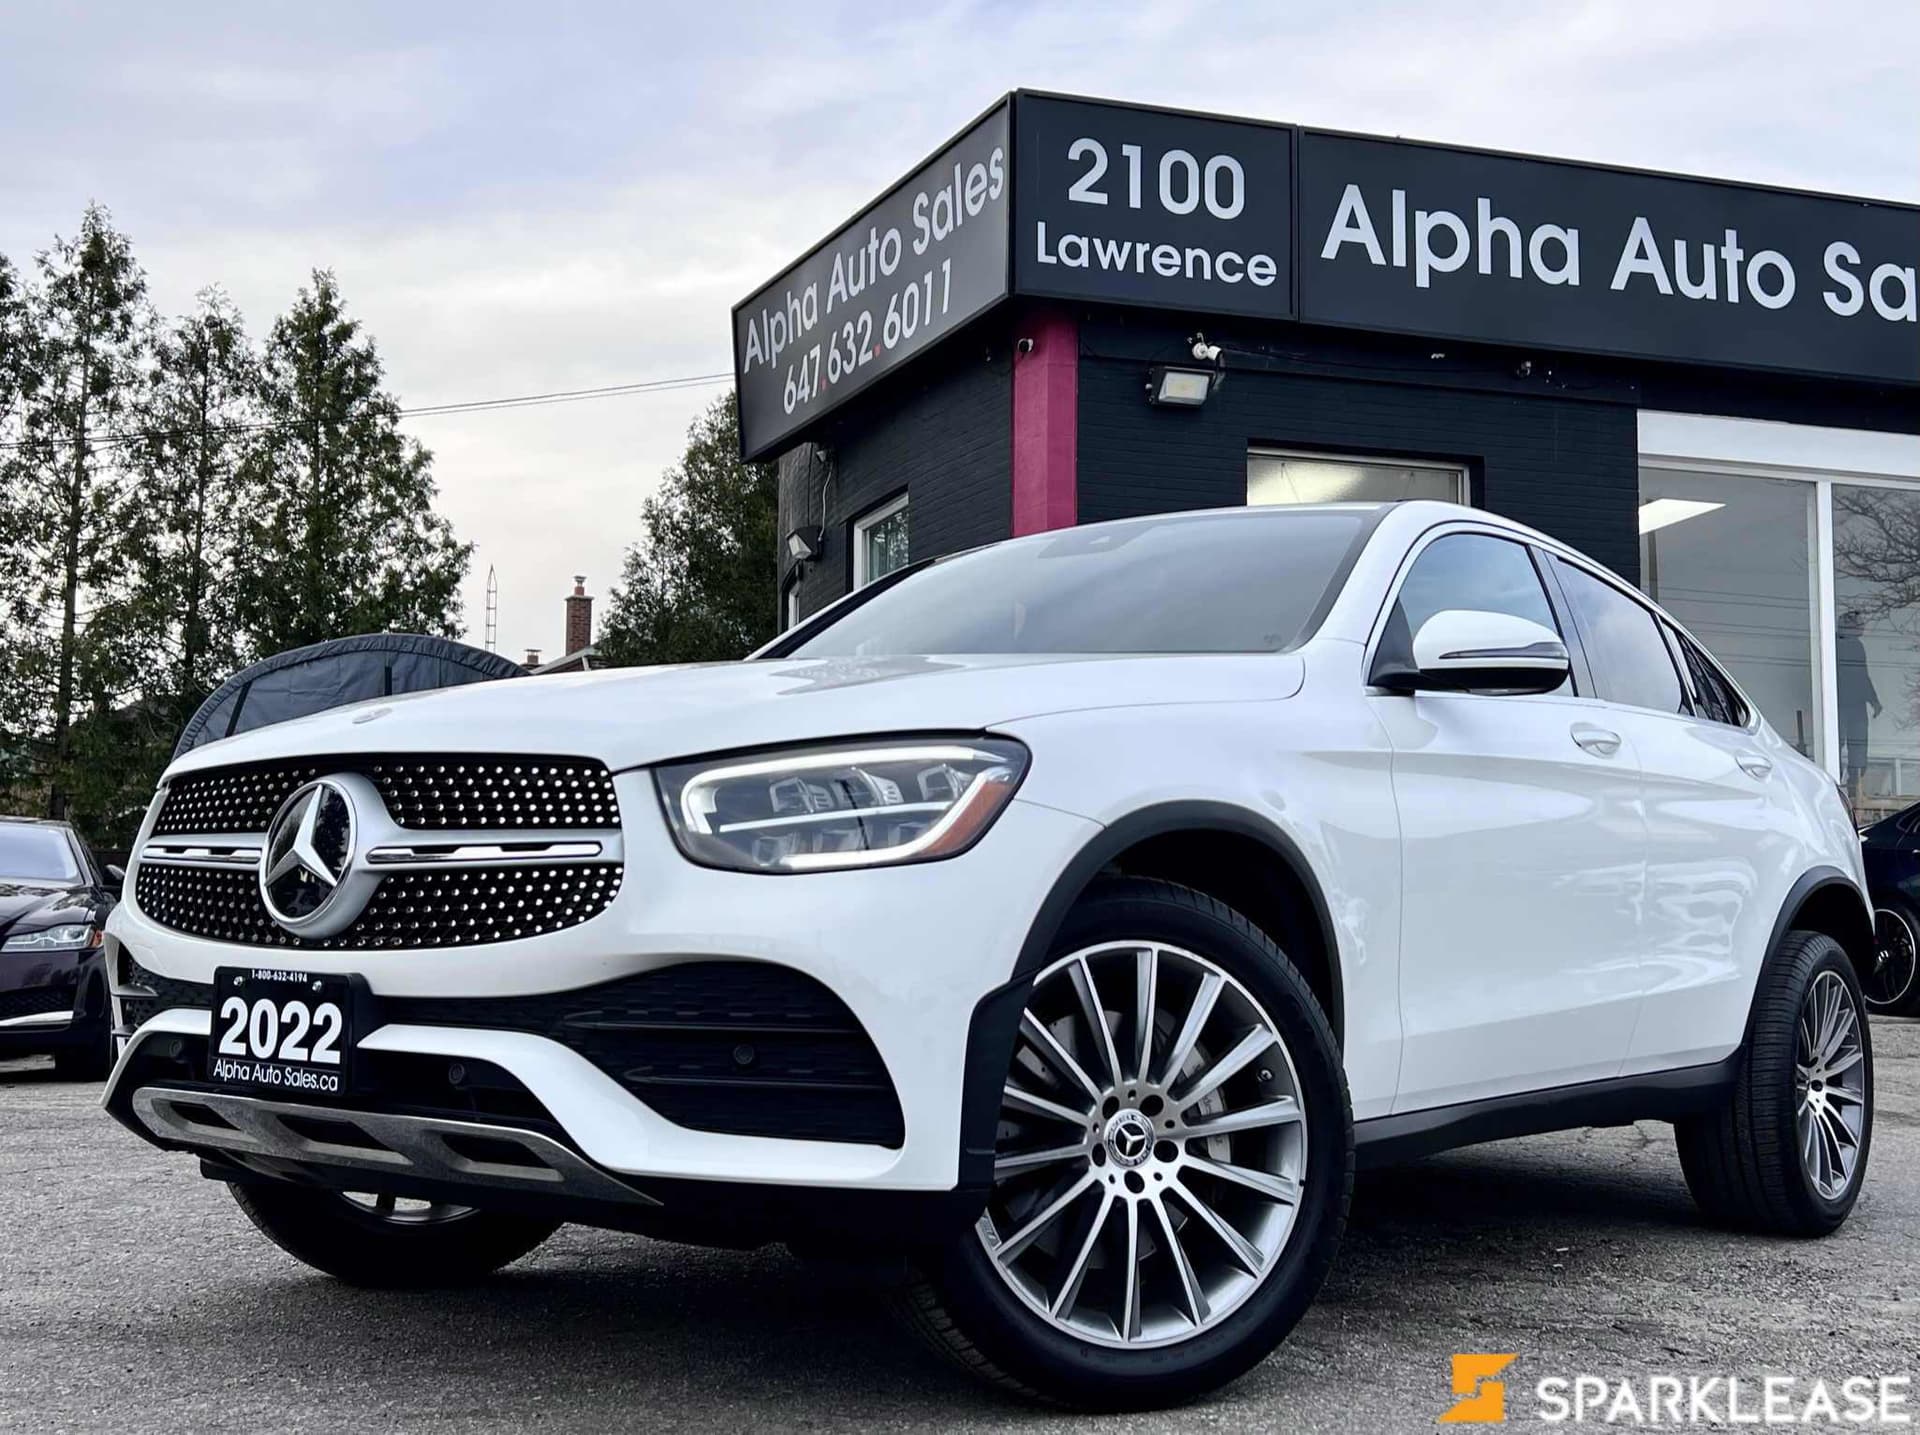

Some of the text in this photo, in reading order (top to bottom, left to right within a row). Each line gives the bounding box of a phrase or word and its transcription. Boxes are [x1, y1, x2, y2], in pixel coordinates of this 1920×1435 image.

[1068, 137, 1245, 220] 2100
[744, 146, 1004, 374] Alpha Auto Sales
[1037, 220, 1278, 287] Lawrence
[1320, 183, 1917, 322] Alpha Auto Sa
[218, 996, 343, 1065] 2022
[213, 1058, 339, 1092] Alpha Auto Sales.ca
